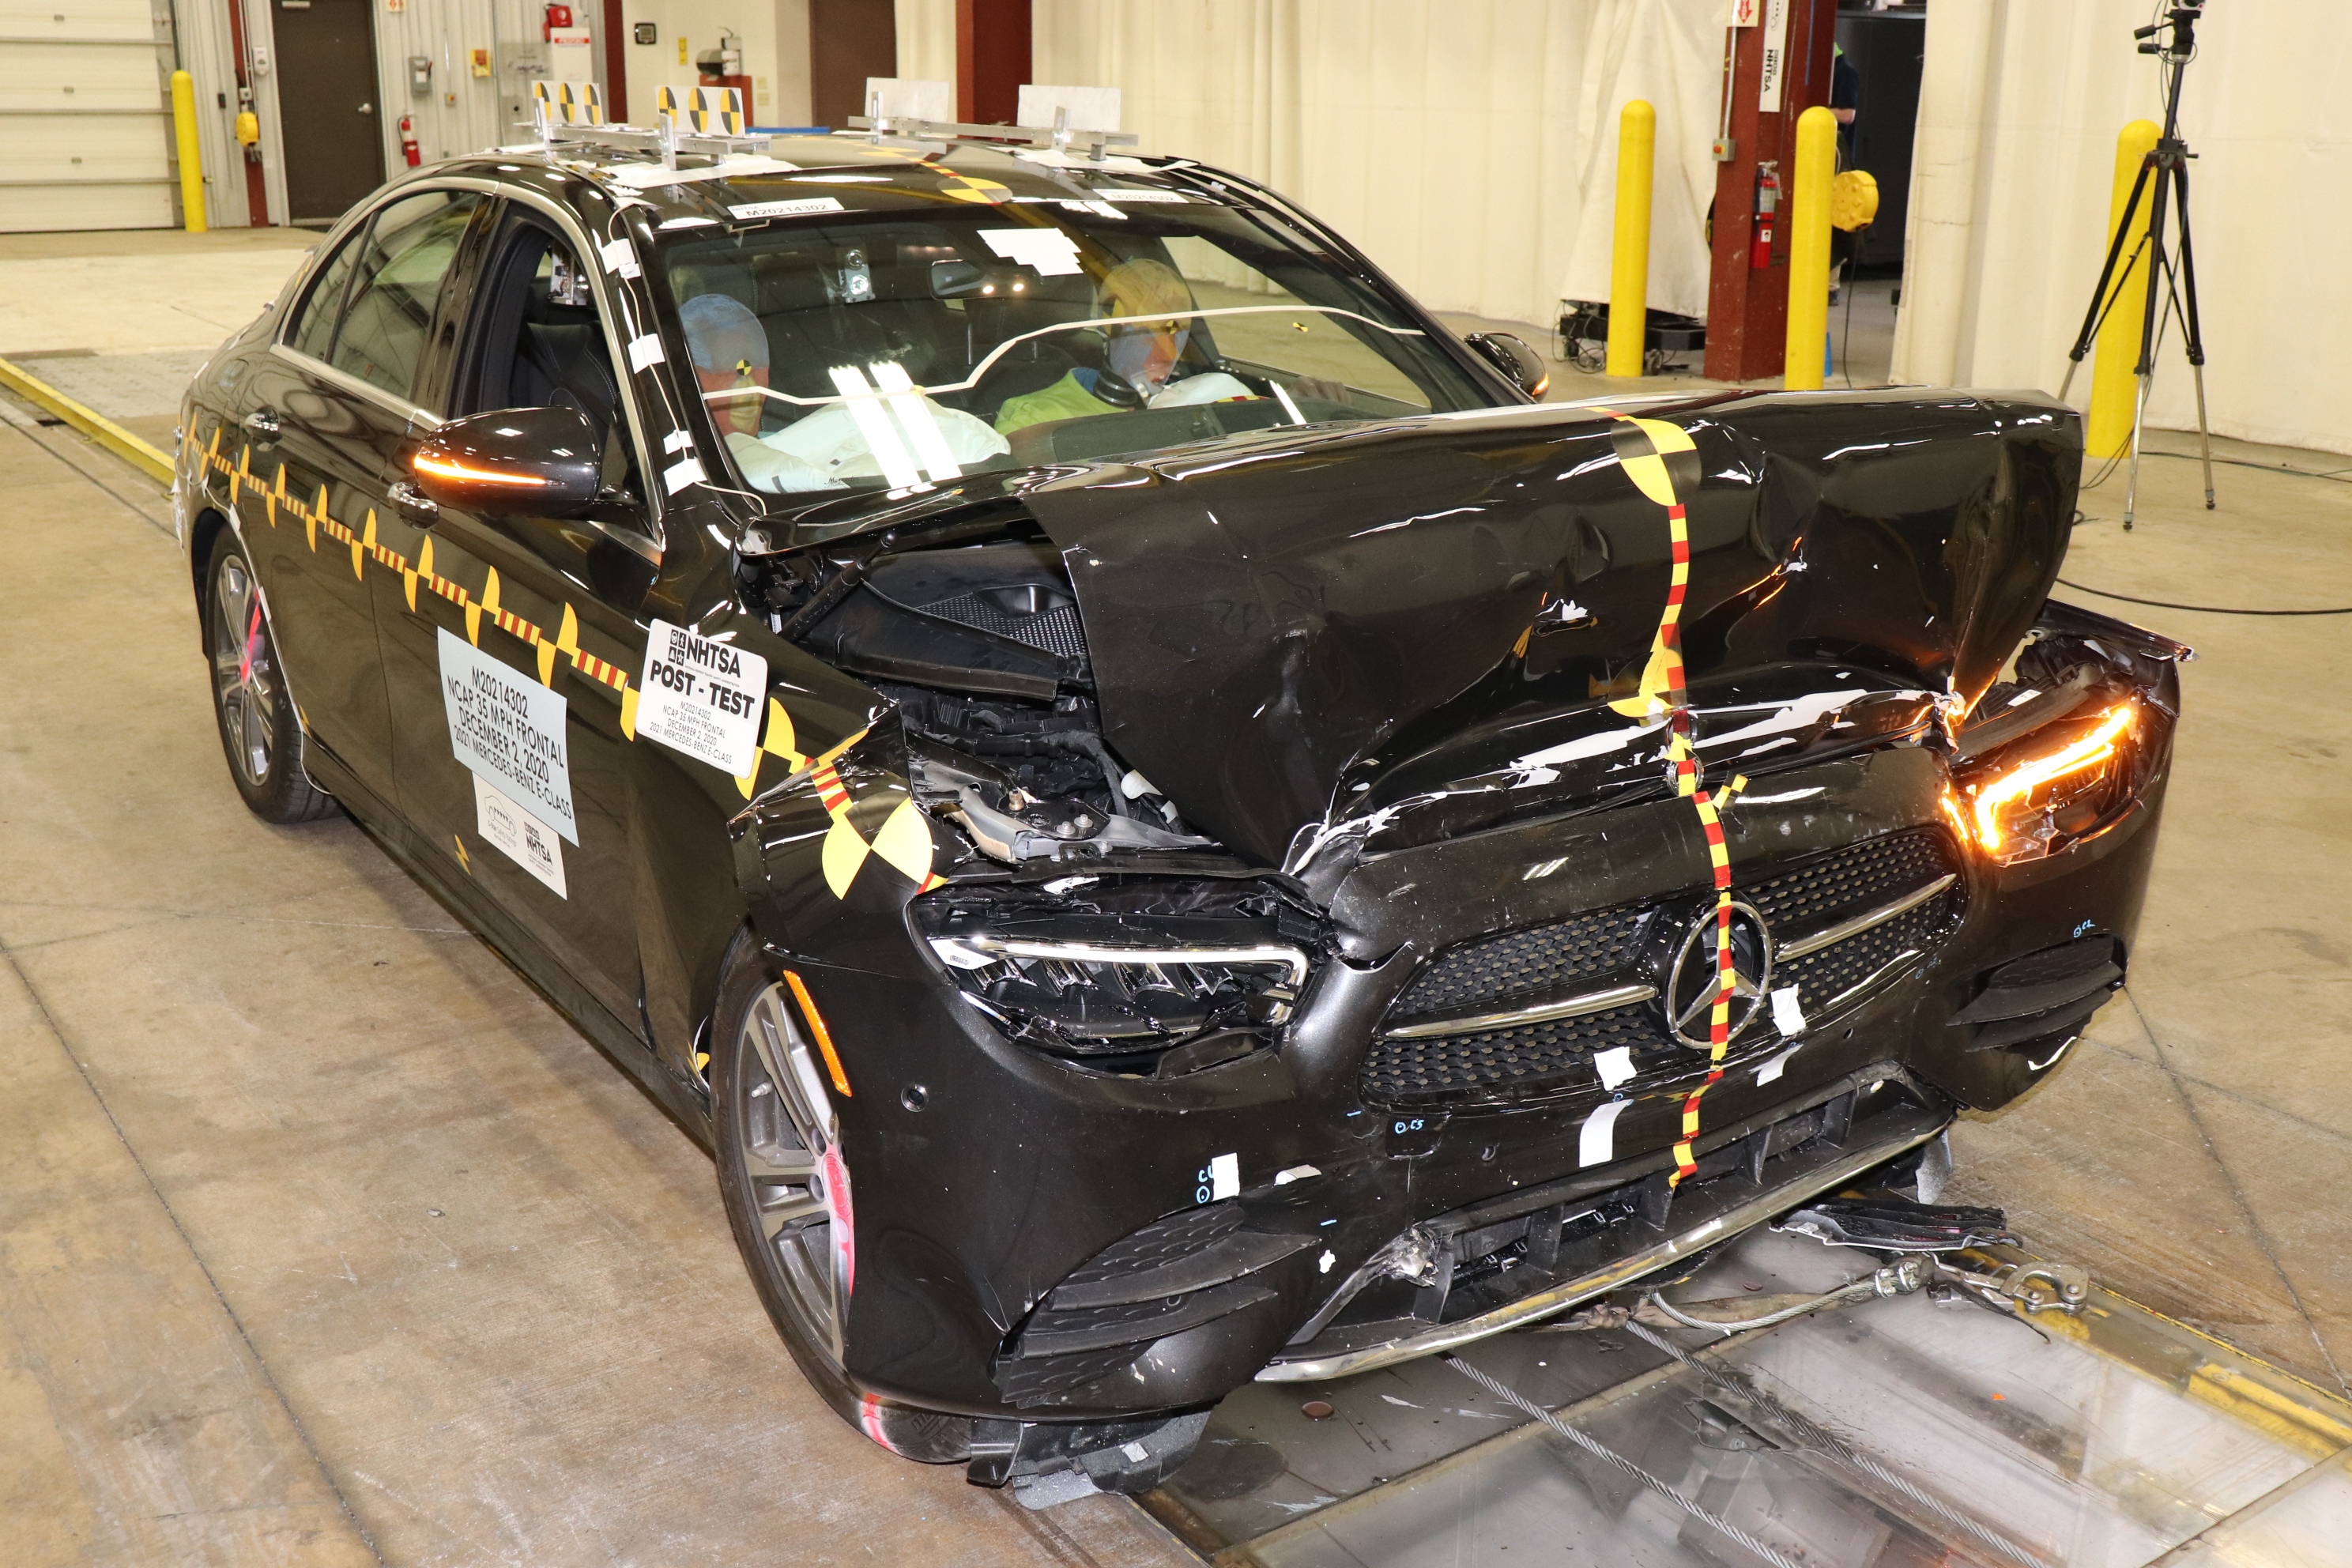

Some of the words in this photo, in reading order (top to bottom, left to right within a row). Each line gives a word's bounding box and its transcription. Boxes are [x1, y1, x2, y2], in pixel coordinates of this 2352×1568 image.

[1764, 49, 1774, 92] NHTSA
[745, 204, 829, 217] M20214302
[686, 635, 741, 679] NHTSA
[472, 665, 529, 720] M20214302
[650, 659, 695, 696] POST
[709, 681, 756, 719] TEST
[680, 700, 711, 721] M20214302
[447, 674, 473, 710] NCAP
[476, 693, 488, 719] 35
[490, 702, 514, 737] MPH
[515, 718, 564, 769] FRONTAL
[649, 722, 662, 734] 2021
[663, 727, 708, 754] MERCEDES-BENZ
[707, 746, 733, 764] E-CLASS
[662, 704, 679, 718] NCAP
[679, 711, 687, 722] 35
[687, 714, 700, 728] MPH
[701, 722, 726, 739] FRONTAL
[667, 718, 697, 738] DECEMBER
[703, 733, 718, 746] 2020
[458, 705, 511, 759] DECEMBER
[511, 740, 522, 768] 2,
[523, 748, 549, 784] 2020
[454, 724, 471, 750] 2021
[473, 738, 536, 795] MERCEDES-BENZ
[536, 781, 572, 820] E-CLASS
[525, 831, 553, 866] NHTSA
